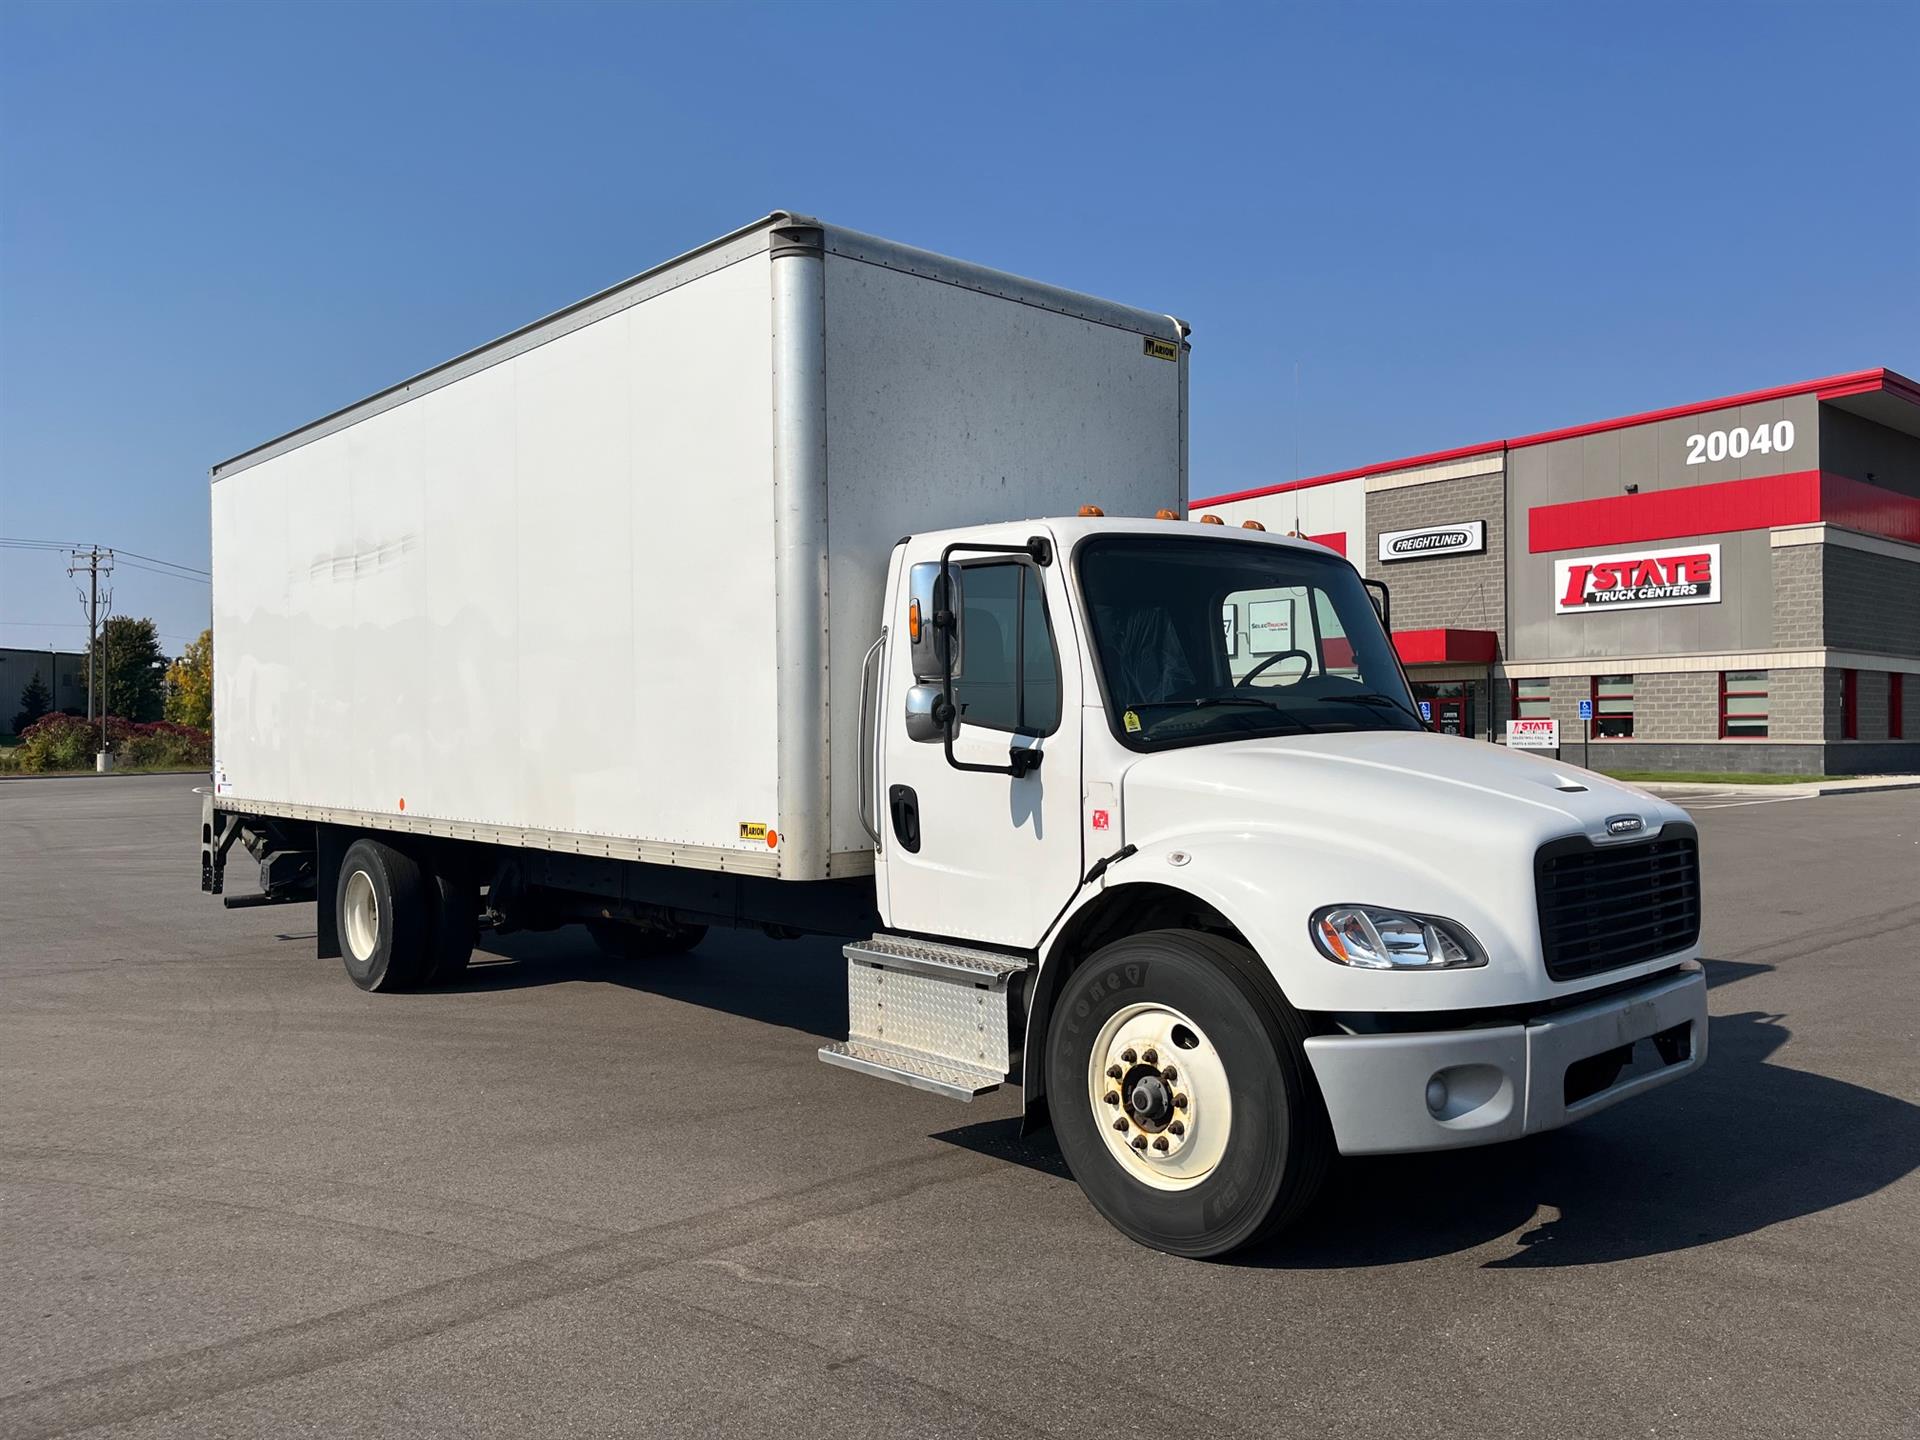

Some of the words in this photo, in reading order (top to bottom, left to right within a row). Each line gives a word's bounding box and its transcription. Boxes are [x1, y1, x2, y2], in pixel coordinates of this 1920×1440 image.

[1686, 420, 1795, 465] 20040
[1395, 534, 1465, 551] FREIGHTLINER
[1592, 554, 1711, 590] STATE
[1595, 590, 1635, 602] TRUCK
[1639, 585, 1697, 599] CENTERS
[740, 824, 764, 836] MARION
